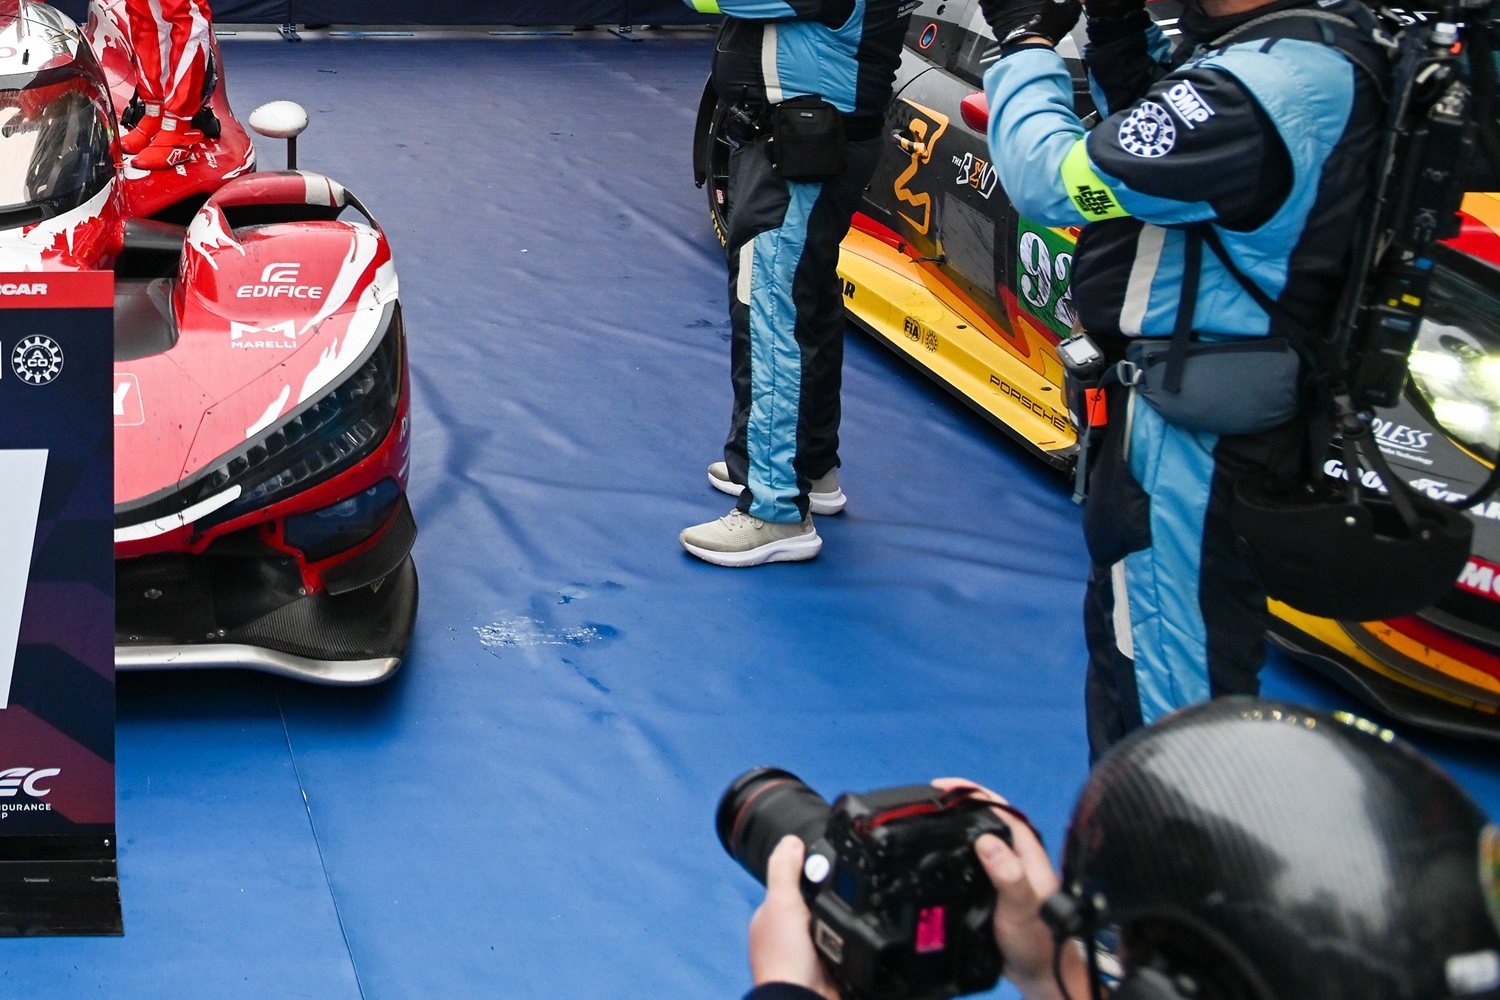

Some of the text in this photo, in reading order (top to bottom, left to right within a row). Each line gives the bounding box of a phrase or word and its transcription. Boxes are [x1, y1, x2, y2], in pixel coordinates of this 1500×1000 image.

[1169, 83, 1209, 123] OMP
[951, 154, 963, 168] THE
[1077, 185, 1108, 215] ACCESS
[1094, 189, 1116, 209] FULL
[236, 284, 323, 300] EDIFICE
[903, 318, 920, 340] FIA
[231, 340, 297, 349] MARELLI
[26, 350, 49, 368] ACO
[989, 373, 1066, 433] PORSCHE
